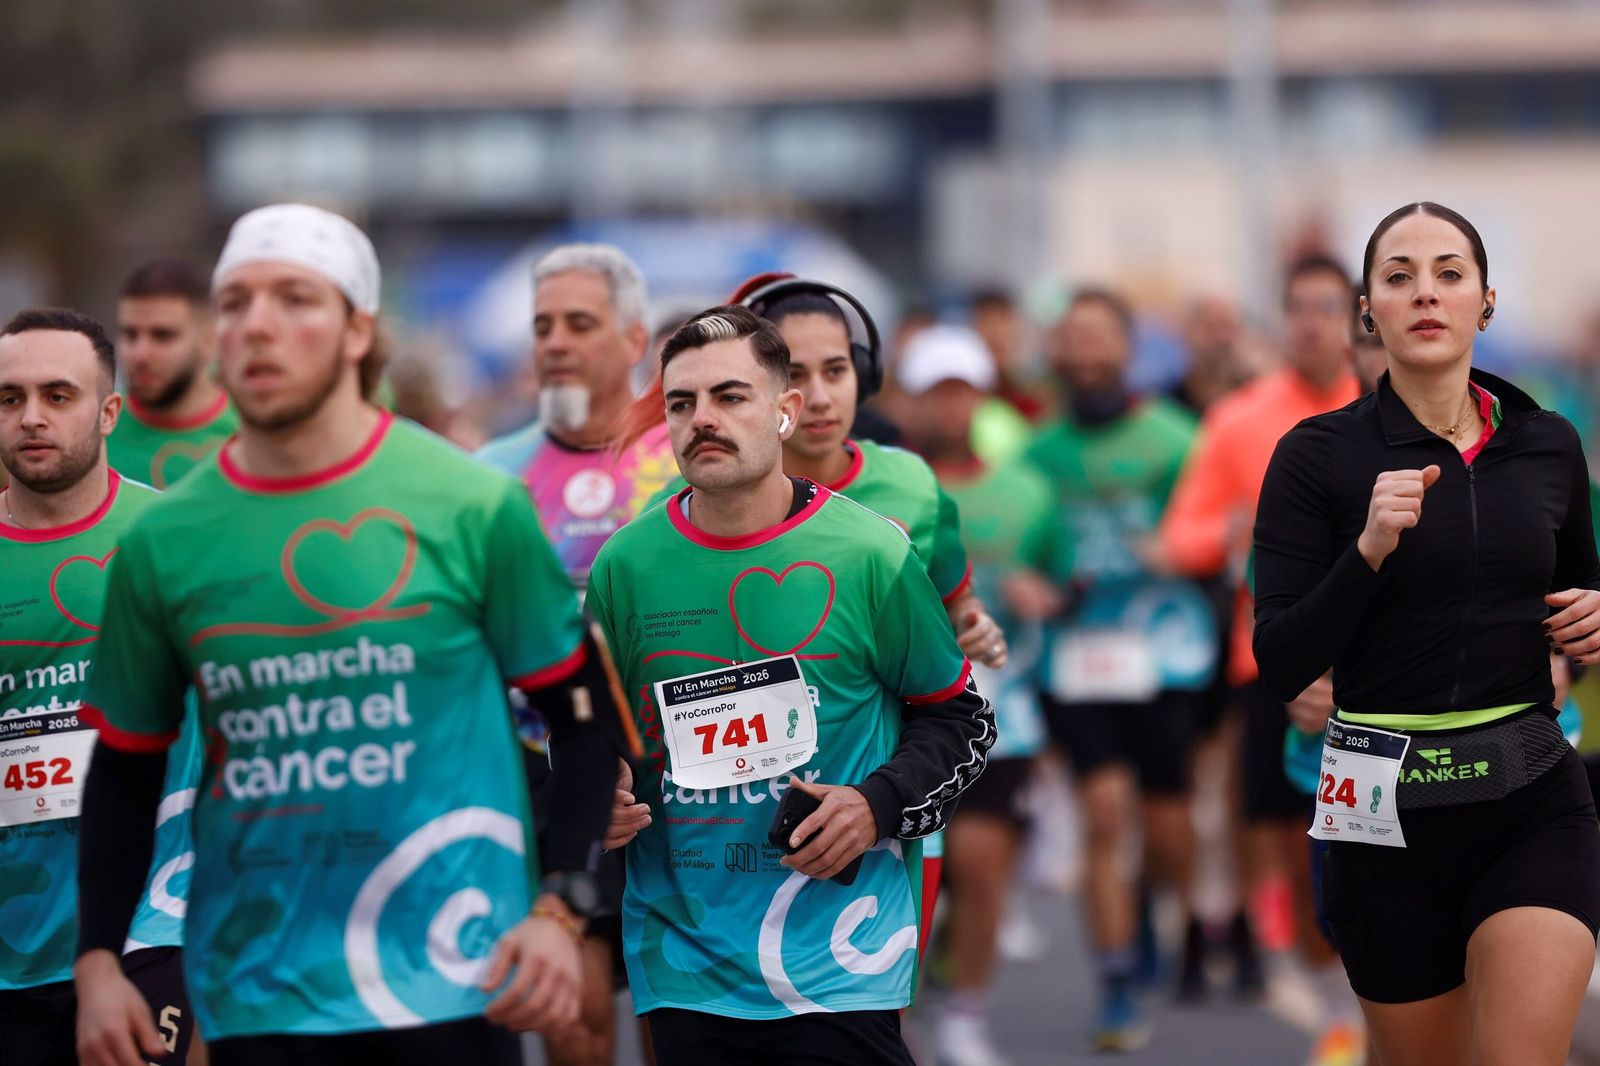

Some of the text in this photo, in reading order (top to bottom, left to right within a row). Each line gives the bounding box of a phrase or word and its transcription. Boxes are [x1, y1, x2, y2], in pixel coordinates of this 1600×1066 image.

[683, 607, 718, 617] española
[644, 621, 667, 630] contra
[0, 659, 91, 693] n mar
[200, 636, 415, 699] En marcha
[672, 669, 769, 695] IV En Marcha 2026
[218, 679, 412, 742] contra el
[674, 702, 737, 722] #YoCorroPor
[9, 719, 43, 732] Marcha
[48, 715, 79, 730] 2026
[694, 713, 768, 755] 741
[0, 745, 40, 758] oCorroPor
[1345, 736, 1370, 748] 2026
[4, 757, 73, 791] 452
[222, 741, 416, 799] cáncer
[671, 848, 703, 858] Ciudad
